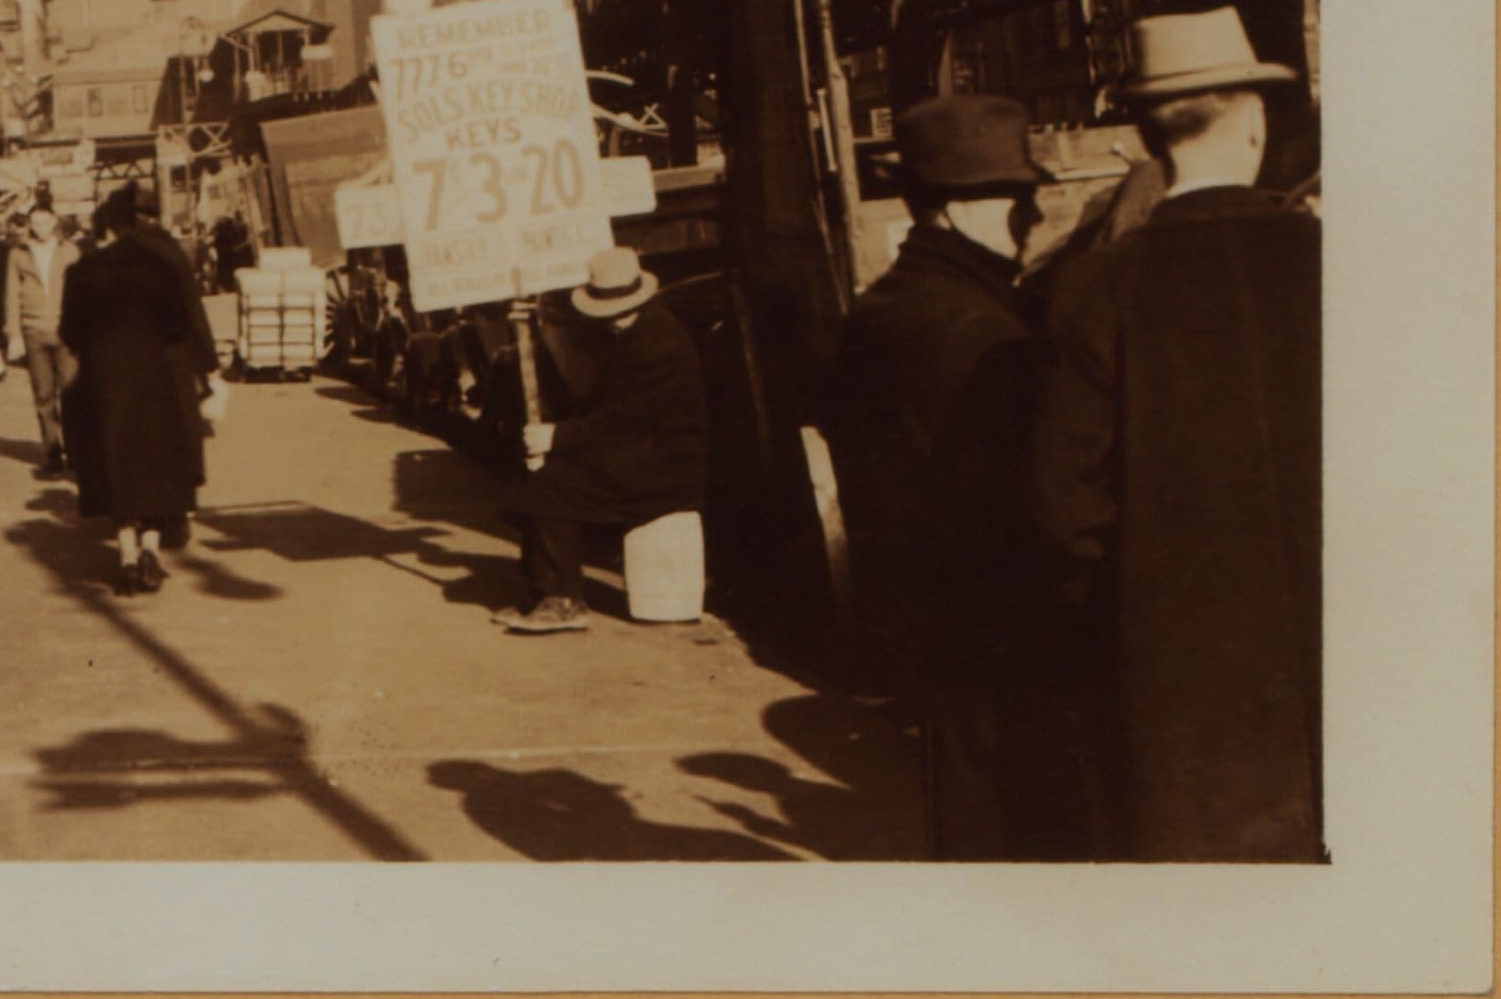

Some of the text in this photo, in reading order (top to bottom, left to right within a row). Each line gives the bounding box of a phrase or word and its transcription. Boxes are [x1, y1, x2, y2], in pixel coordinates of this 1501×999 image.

[397, 9, 551, 50] REMEMBER
[466, 80, 514, 115] KEY
[446, 118, 524, 151] KEYS
[520, 137, 586, 217] 20
